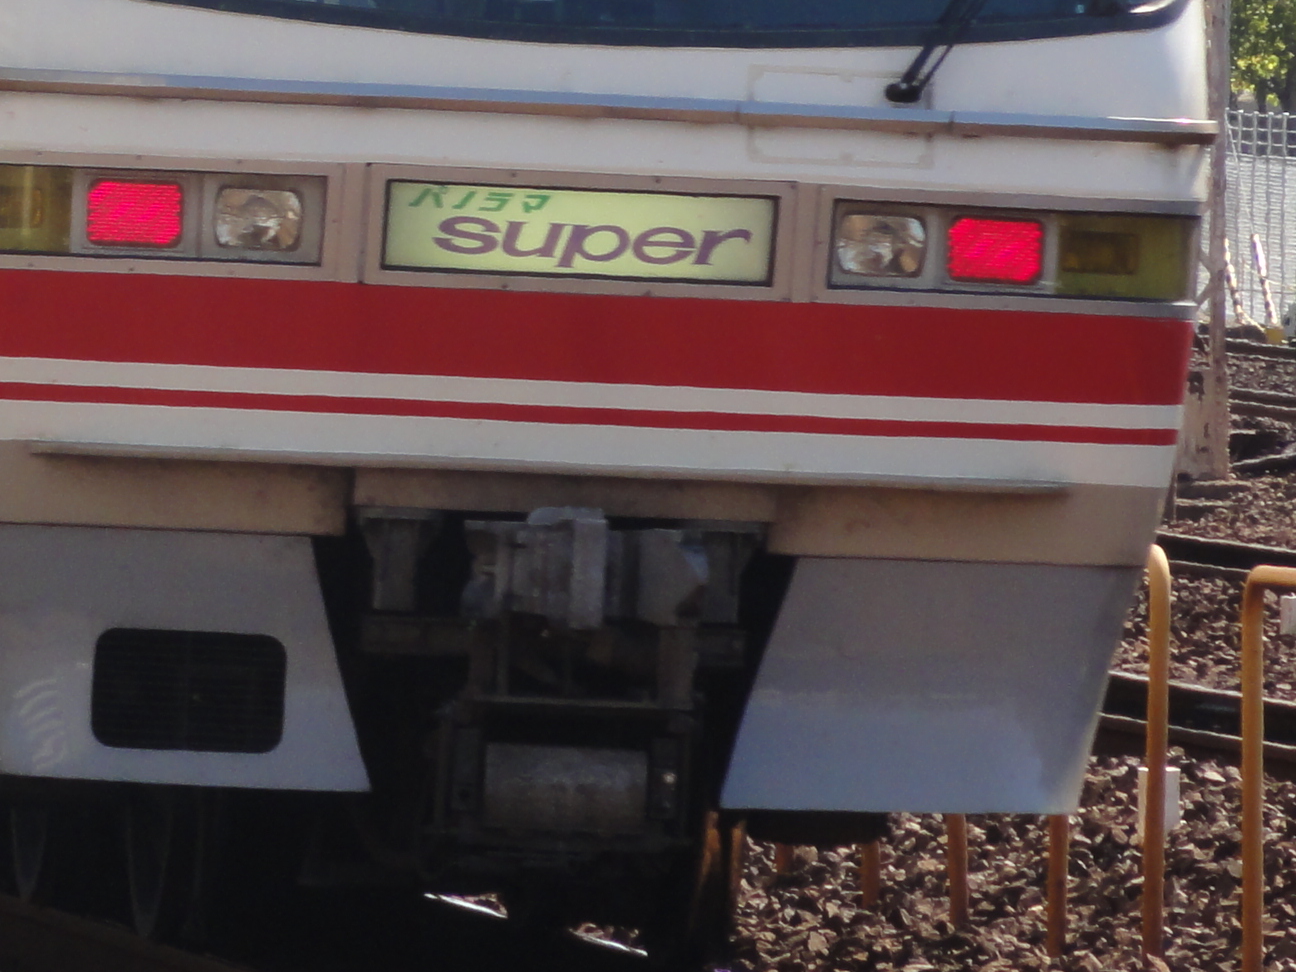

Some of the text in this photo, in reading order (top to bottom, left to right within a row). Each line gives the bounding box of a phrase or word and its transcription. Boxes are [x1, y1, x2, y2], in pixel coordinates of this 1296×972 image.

[408, 185, 552, 214] パノラマ
[432, 215, 753, 268] super
